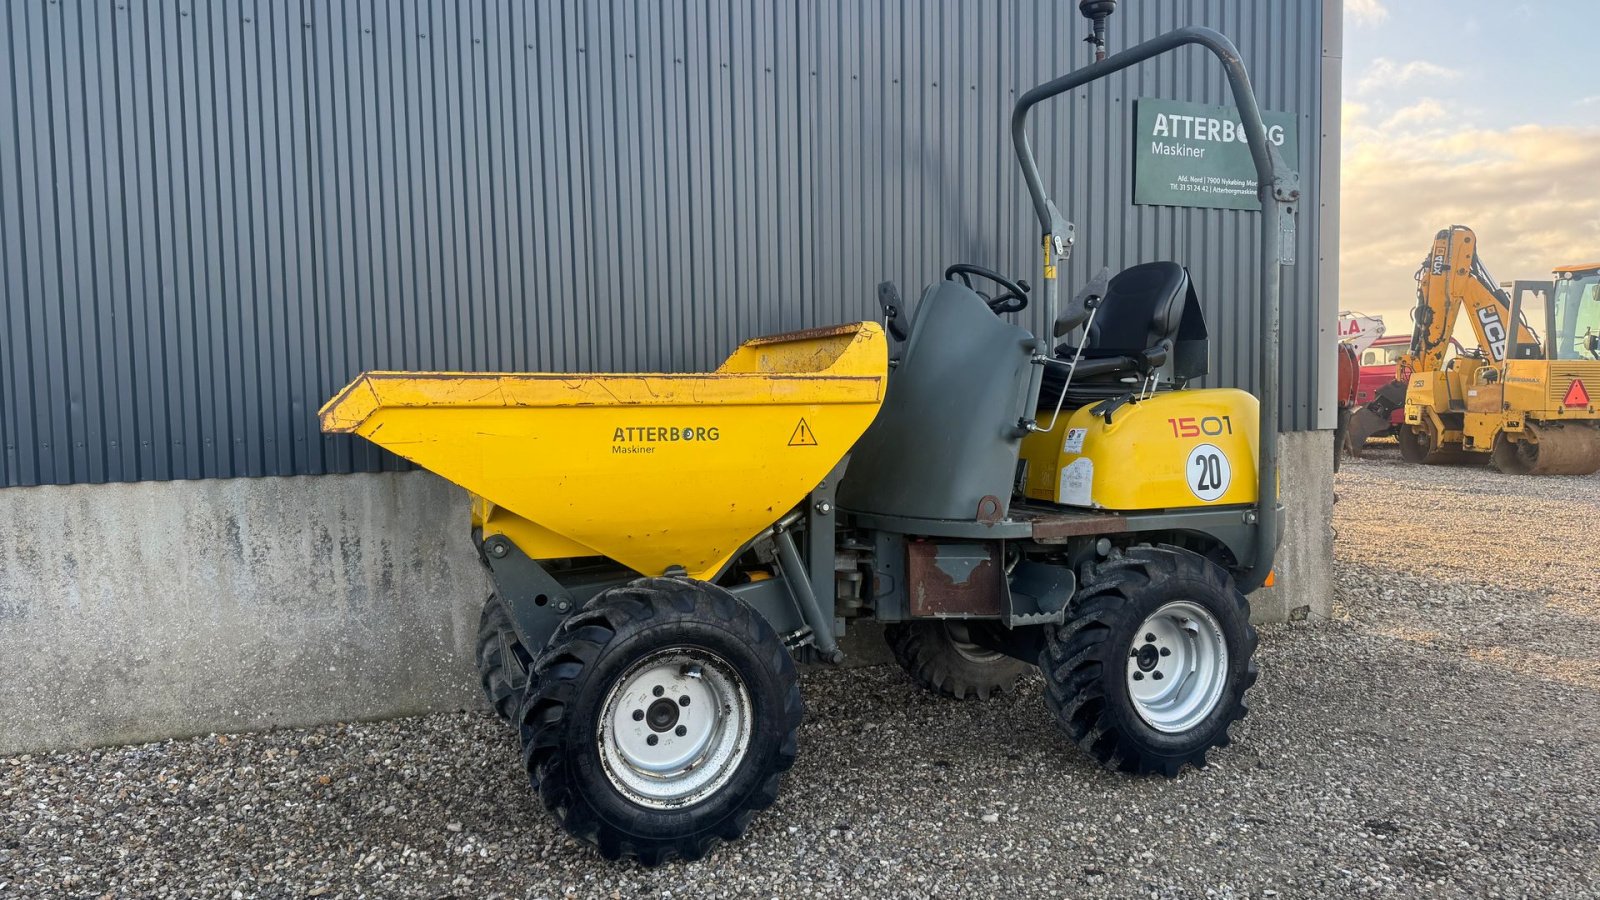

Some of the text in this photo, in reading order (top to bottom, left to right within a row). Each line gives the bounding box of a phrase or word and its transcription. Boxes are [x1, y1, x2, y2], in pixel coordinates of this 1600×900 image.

[1153, 113, 1284, 146] ATTERBG
[1151, 141, 1205, 158] Maskiner
[1202, 185, 1209, 193] 42
[612, 426, 720, 442] ATTERBORG
[1168, 415, 1233, 438] 1501
[612, 445, 656, 454] Maskiner
[1195, 453, 1222, 491] 20
